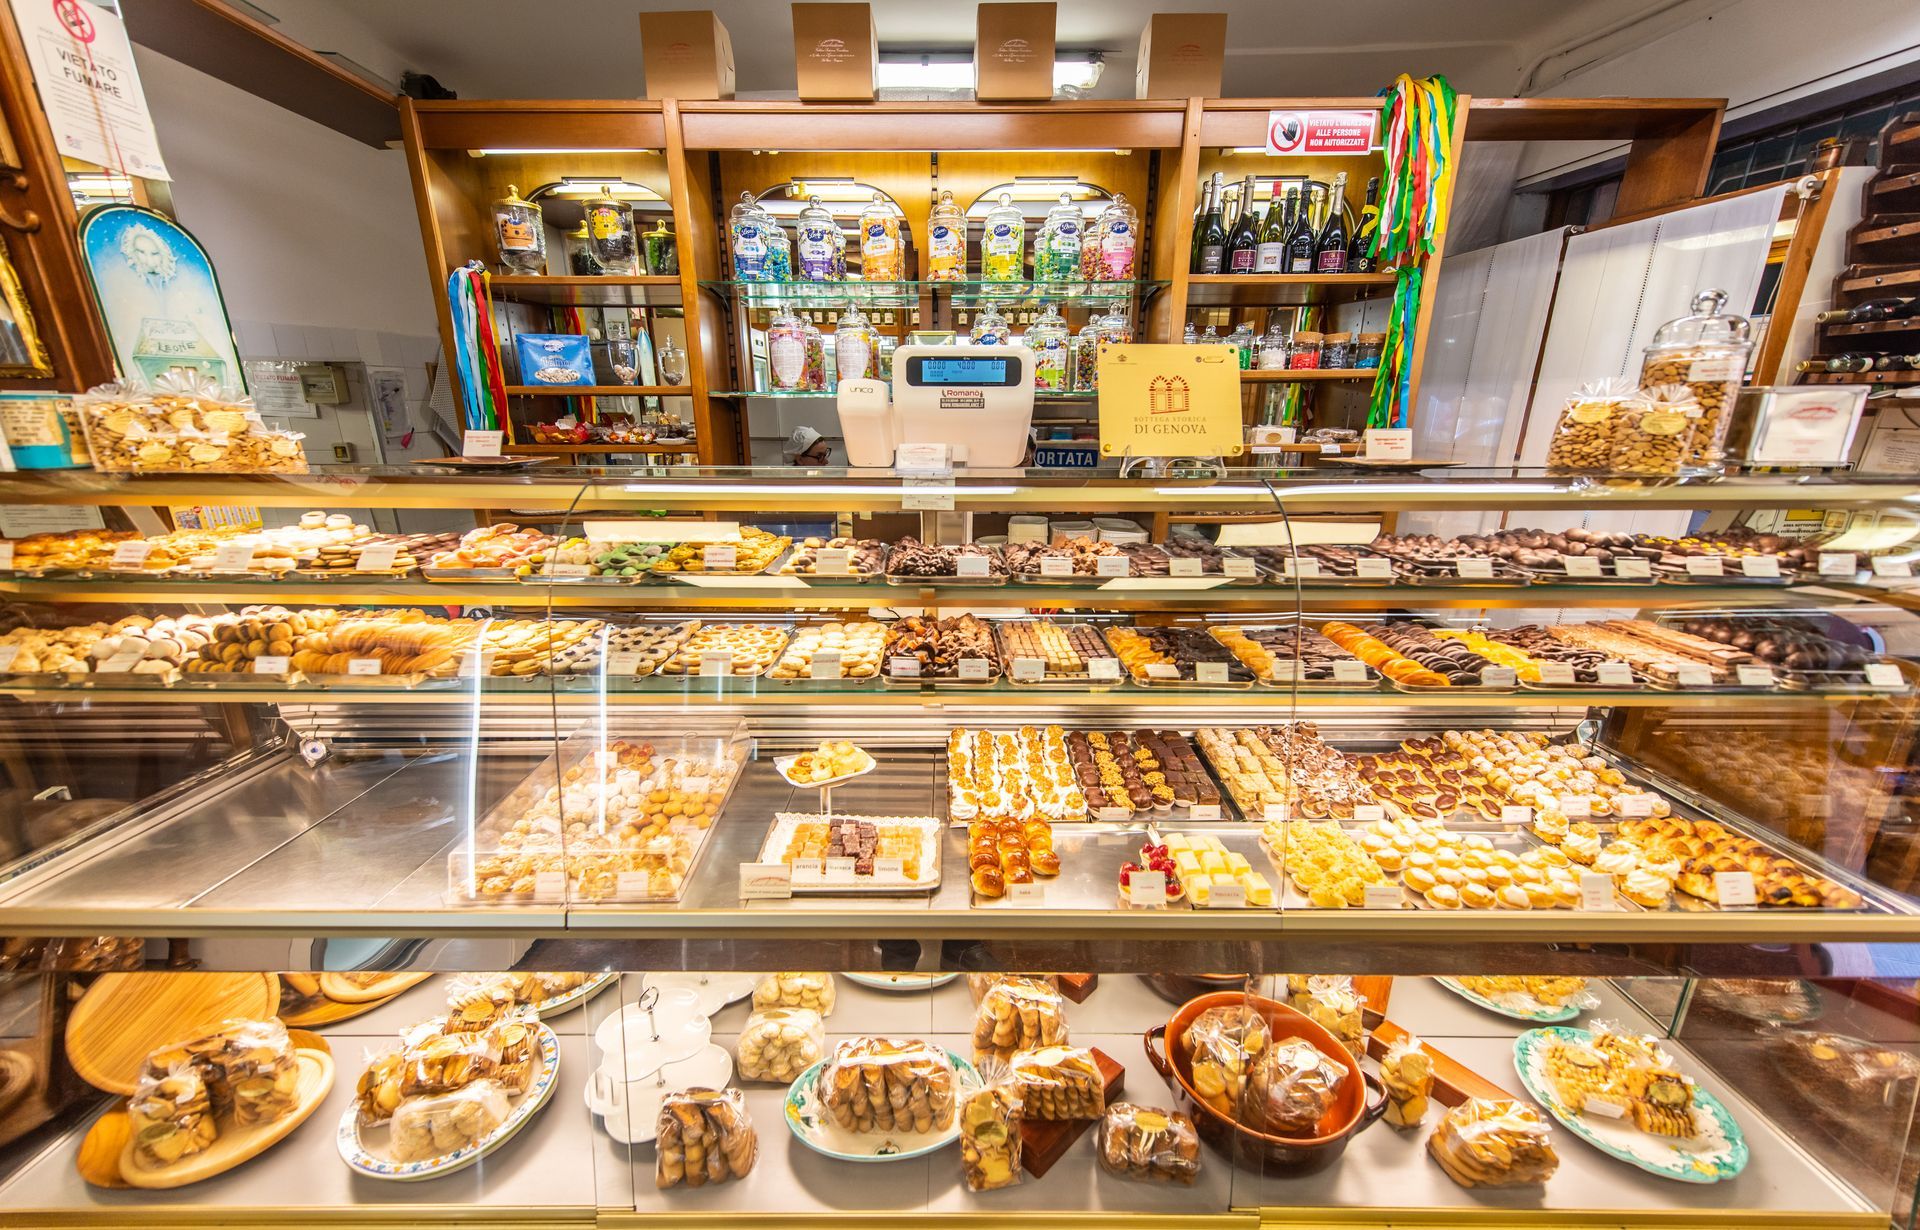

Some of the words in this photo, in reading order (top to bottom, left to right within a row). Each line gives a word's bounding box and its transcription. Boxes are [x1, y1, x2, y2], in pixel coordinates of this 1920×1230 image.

[56, 47, 117, 81] VIETATO
[64, 67, 123, 99] FUMARE
[1309, 119, 1334, 127] VIETATO
[1316, 128, 1331, 136] ALLE
[1332, 128, 1361, 136] PERSONE
[1309, 138, 1323, 146] NON
[1324, 138, 1365, 146] AUTORIZZATE
[1135, 424, 1148, 434] DI
[1153, 424, 1207, 434] GENOVA
